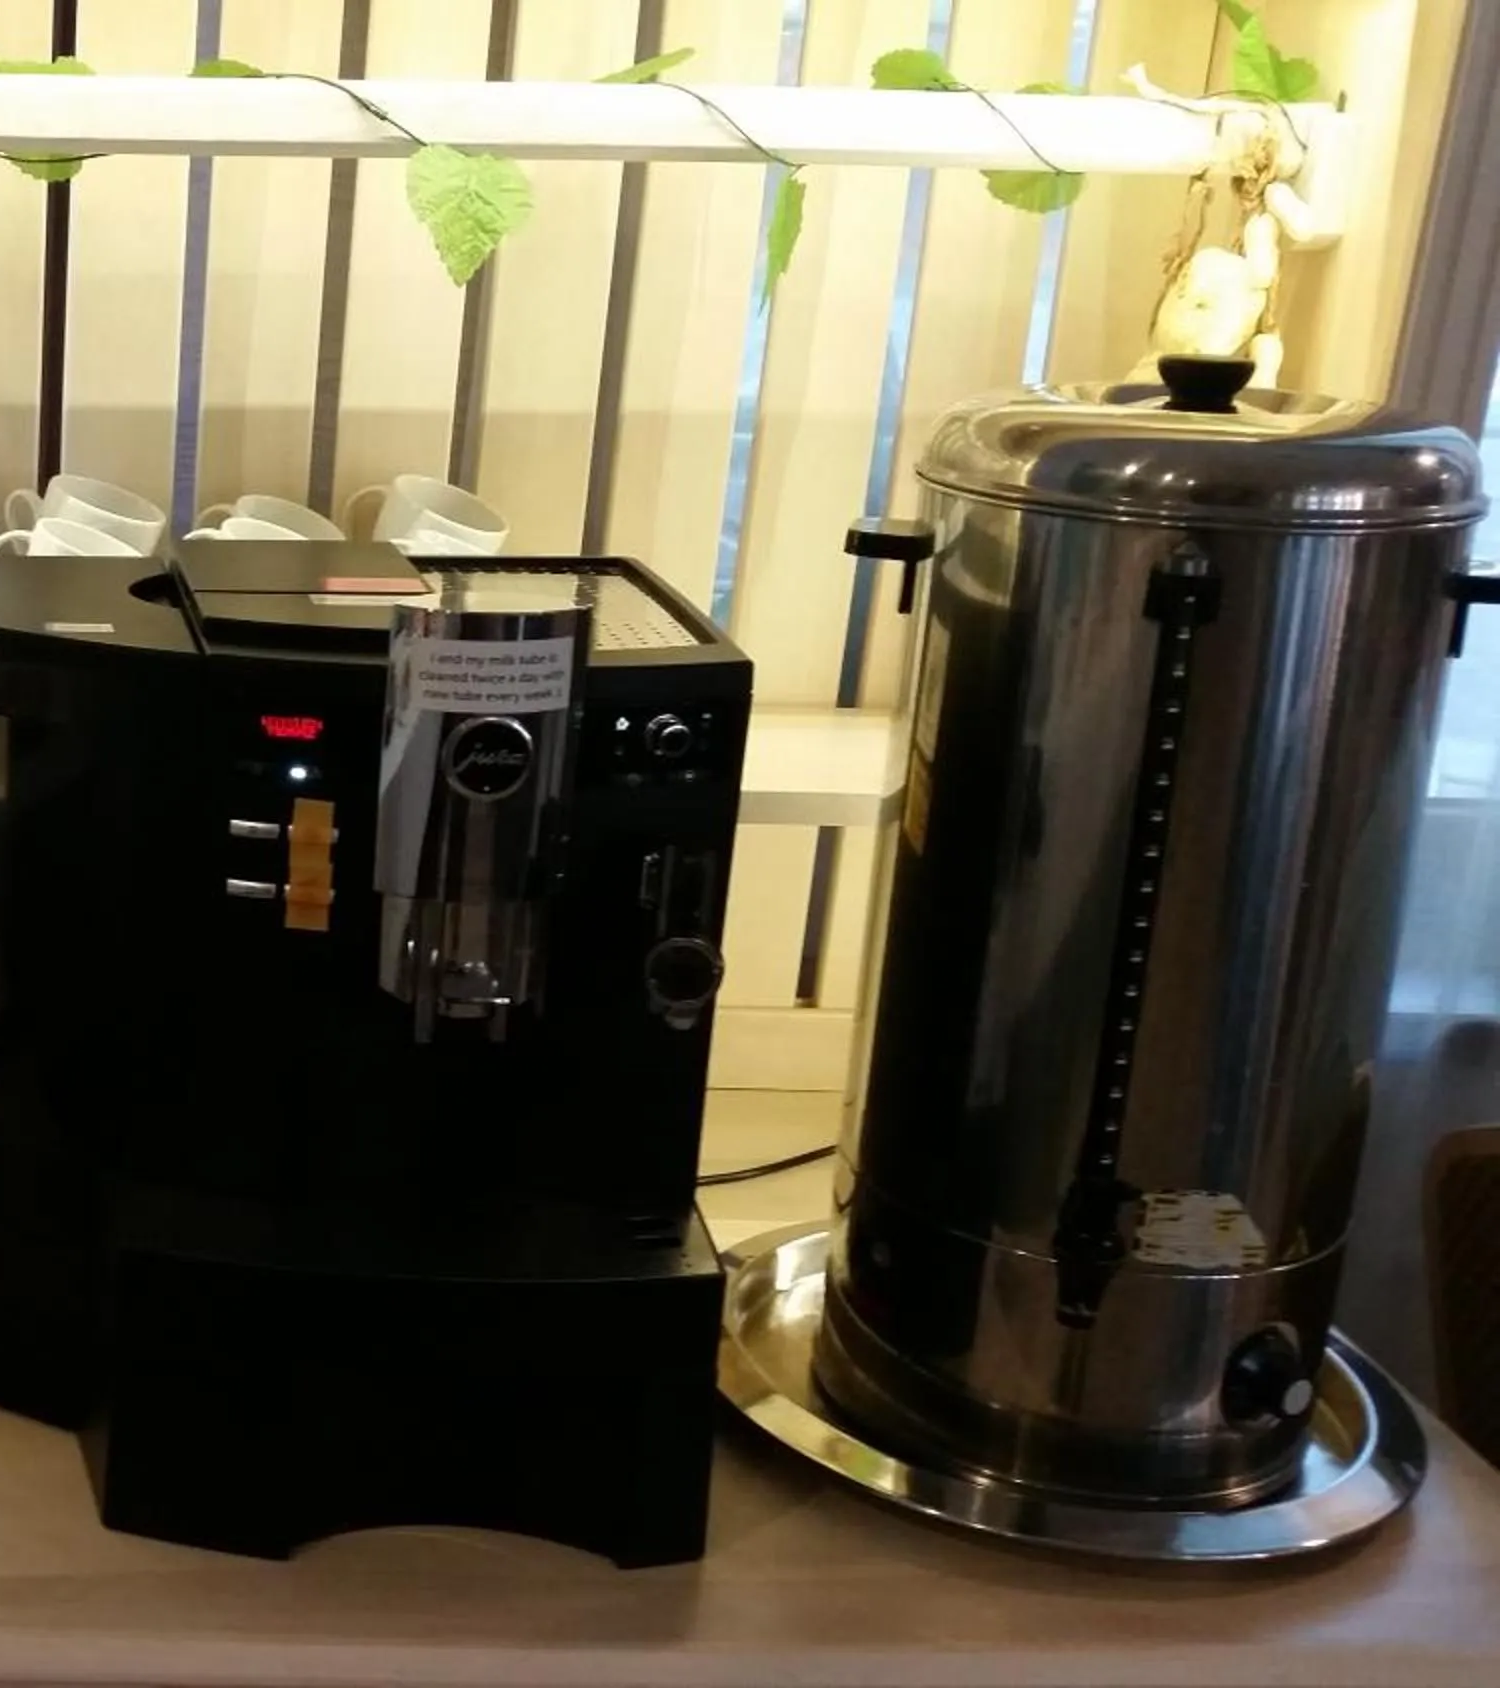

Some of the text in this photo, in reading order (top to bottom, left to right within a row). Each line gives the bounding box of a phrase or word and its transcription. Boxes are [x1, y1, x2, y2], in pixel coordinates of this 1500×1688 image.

[464, 656, 485, 669] my
[489, 653, 515, 665] milk
[518, 653, 547, 665] tube
[470, 672, 506, 685] twice
[508, 674, 516, 683] a
[518, 672, 539, 686] day
[541, 669, 566, 681] with
[452, 689, 483, 701] tube
[485, 692, 521, 705] every
